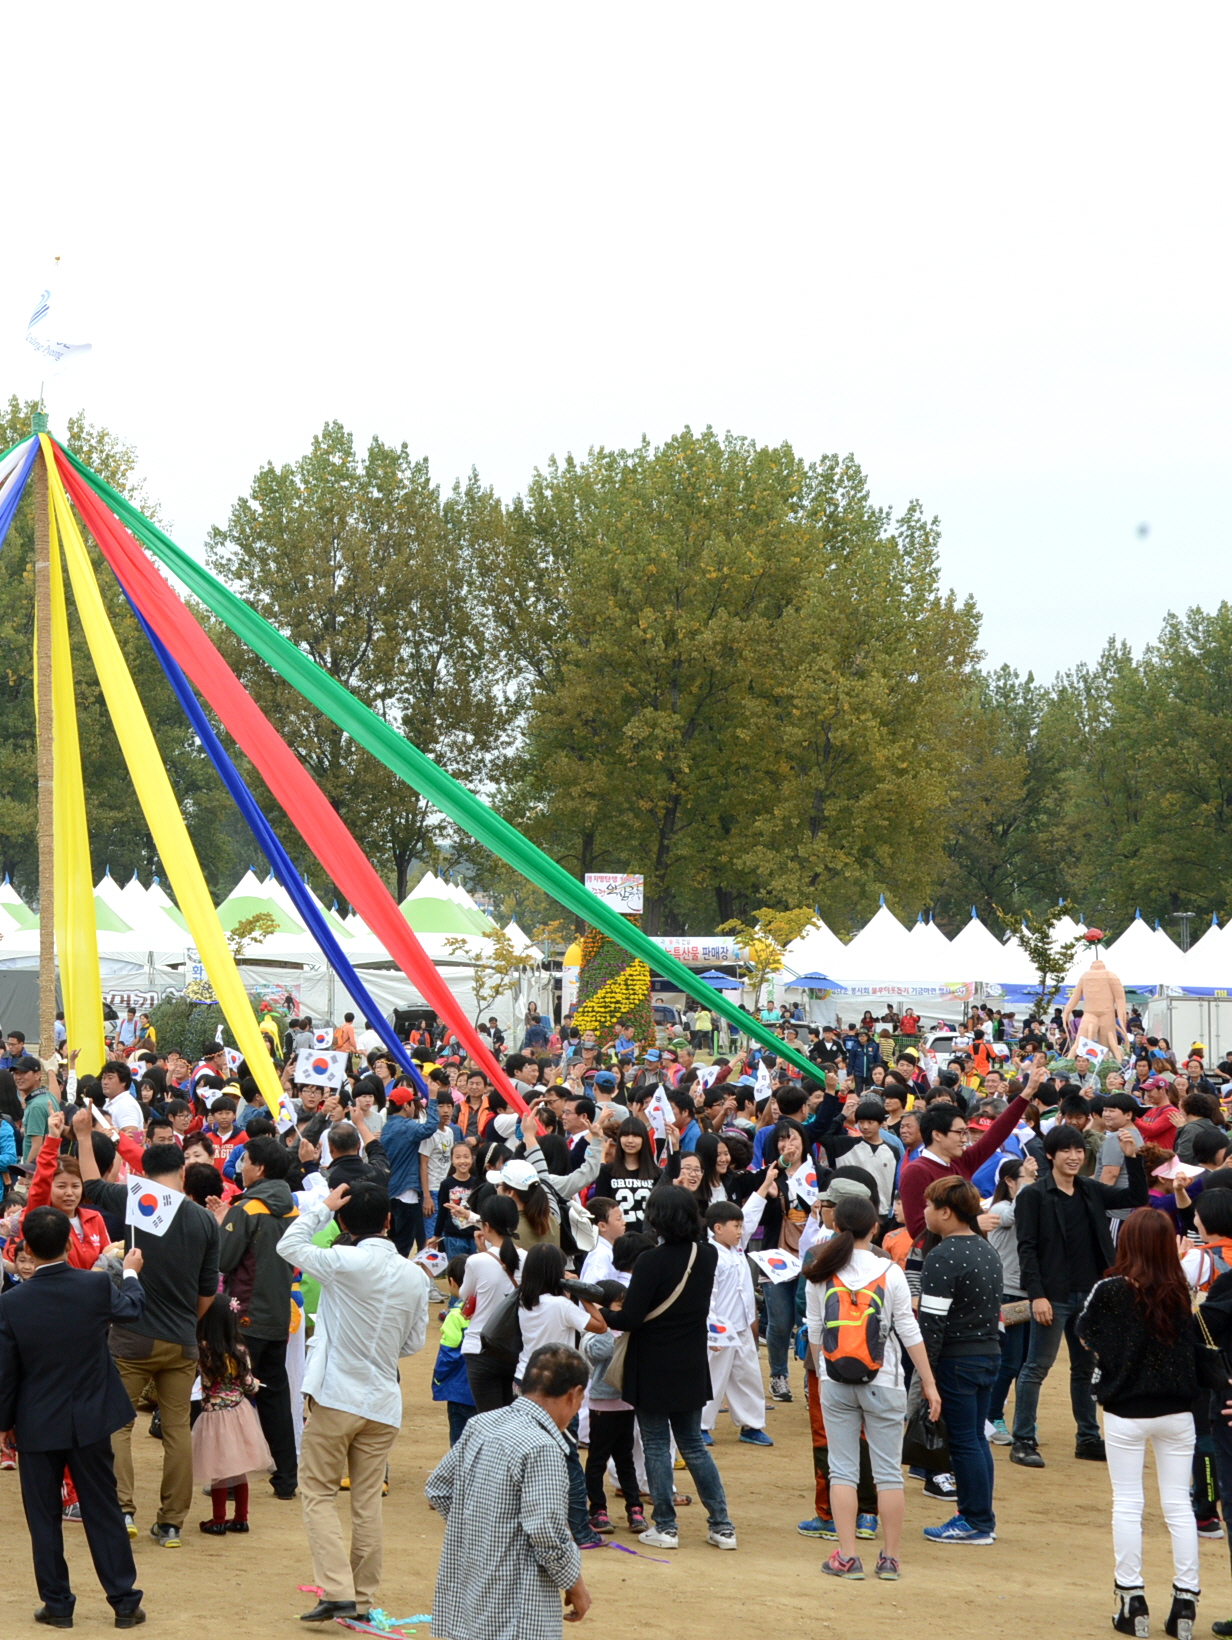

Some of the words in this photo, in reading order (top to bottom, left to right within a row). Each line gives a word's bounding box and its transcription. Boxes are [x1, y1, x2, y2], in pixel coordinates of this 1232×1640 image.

[702, 946, 729, 961] 판매장
[610, 1178, 654, 1189] GRUNGE
[615, 1188, 651, 1223] 23
